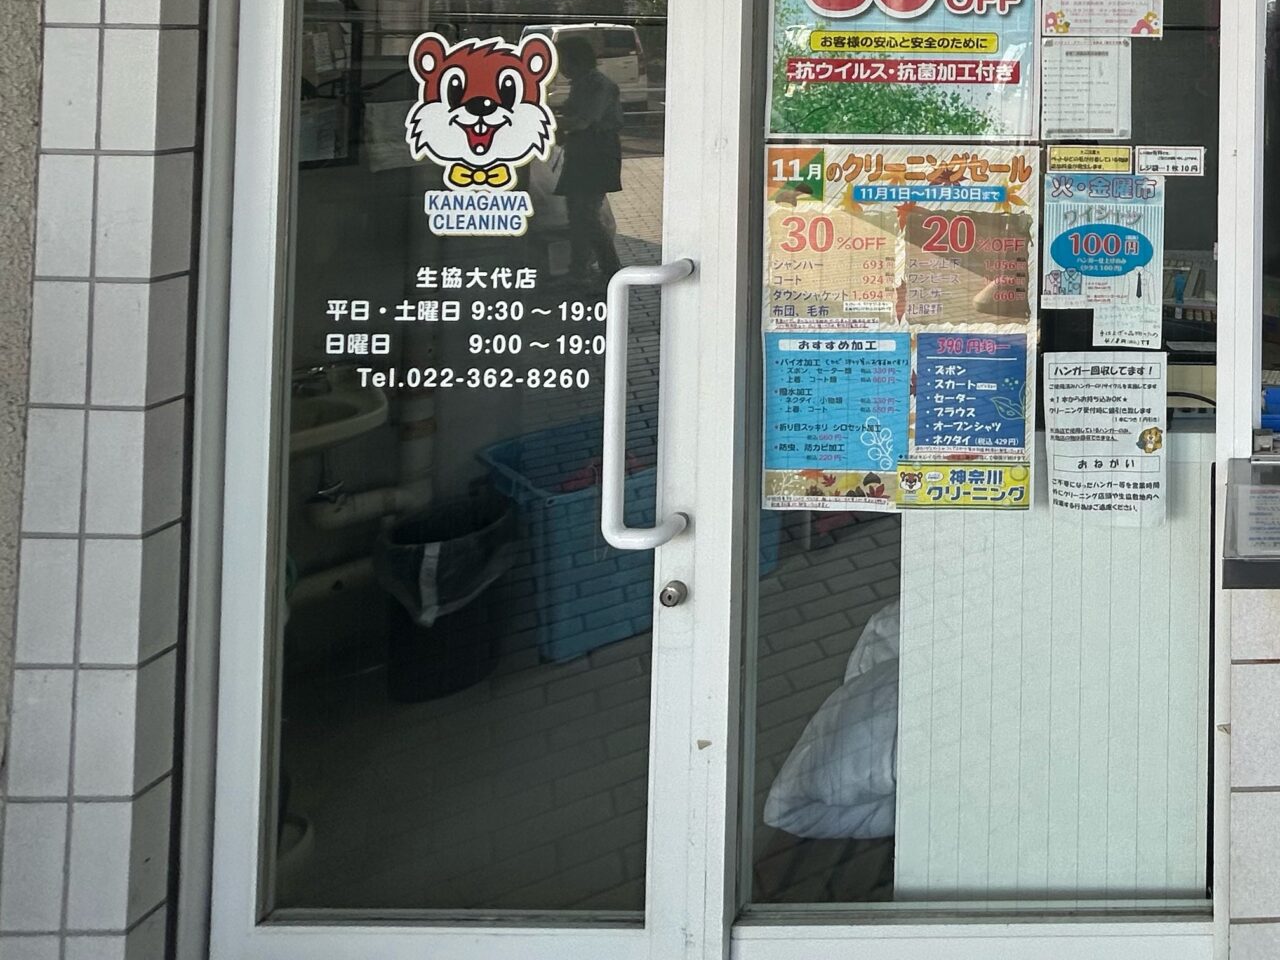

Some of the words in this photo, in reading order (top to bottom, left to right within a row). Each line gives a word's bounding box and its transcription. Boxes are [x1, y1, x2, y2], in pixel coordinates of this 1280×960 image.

[820, 36, 988, 50] お客様の安心と安全のために
[795, 61, 1014, 82] 抗ウイルス・抗菌加工付き
[428, 194, 529, 211] KANAGAWA
[433, 213, 522, 230] CLEANING
[1068, 232, 1139, 256] 100円
[415, 266, 538, 289] 生協大代店
[773, 275, 803, 285] コート
[325, 299, 461, 321] 平日・土曜日
[471, 301, 524, 321] 9:30
[558, 301, 608, 322] 19:0
[772, 304, 830, 318] 布団、毛布
[325, 333, 391, 355] 日曜日
[468, 333, 522, 354] 9:00
[556, 334, 607, 355] 19:0
[798, 340, 878, 351] おすすめ加工
[356, 367, 591, 389] Tel.022-362-8260
[1077, 459, 1135, 470] おねがい
[949, 469, 1004, 485] 神奈川
[926, 486, 1025, 502] クリーニング
